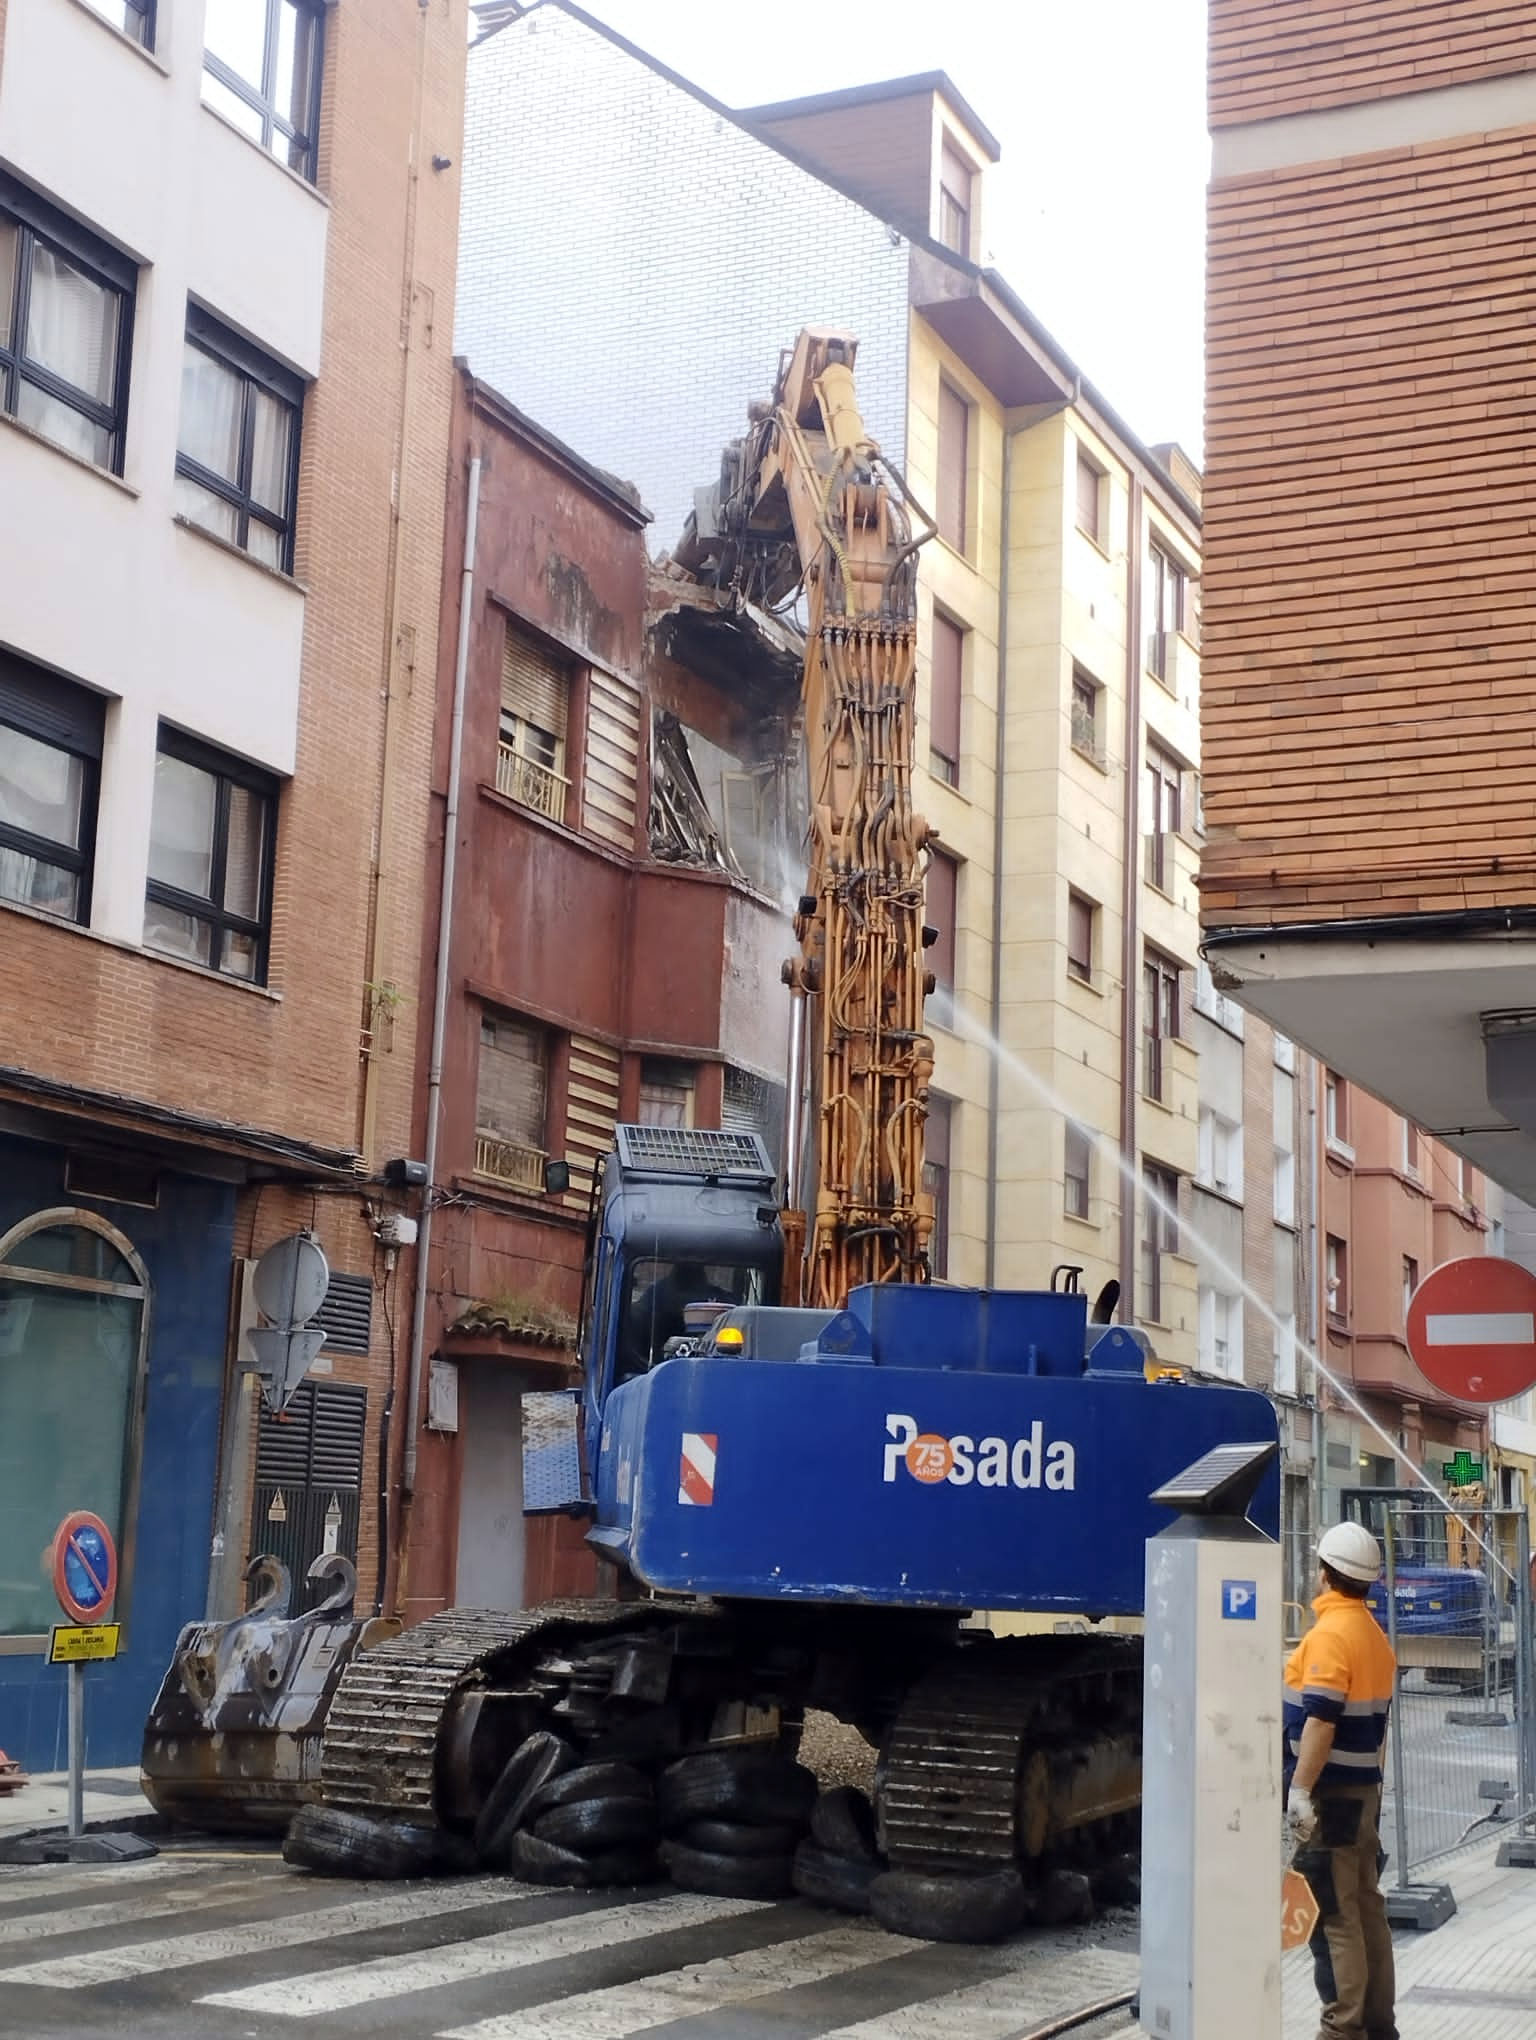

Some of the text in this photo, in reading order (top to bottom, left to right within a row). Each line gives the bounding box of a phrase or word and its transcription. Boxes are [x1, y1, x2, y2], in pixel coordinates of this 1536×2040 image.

[914, 1442, 946, 1466] 75
[915, 1465, 944, 1478] AÑOS
[1230, 1588, 1249, 1613] P
